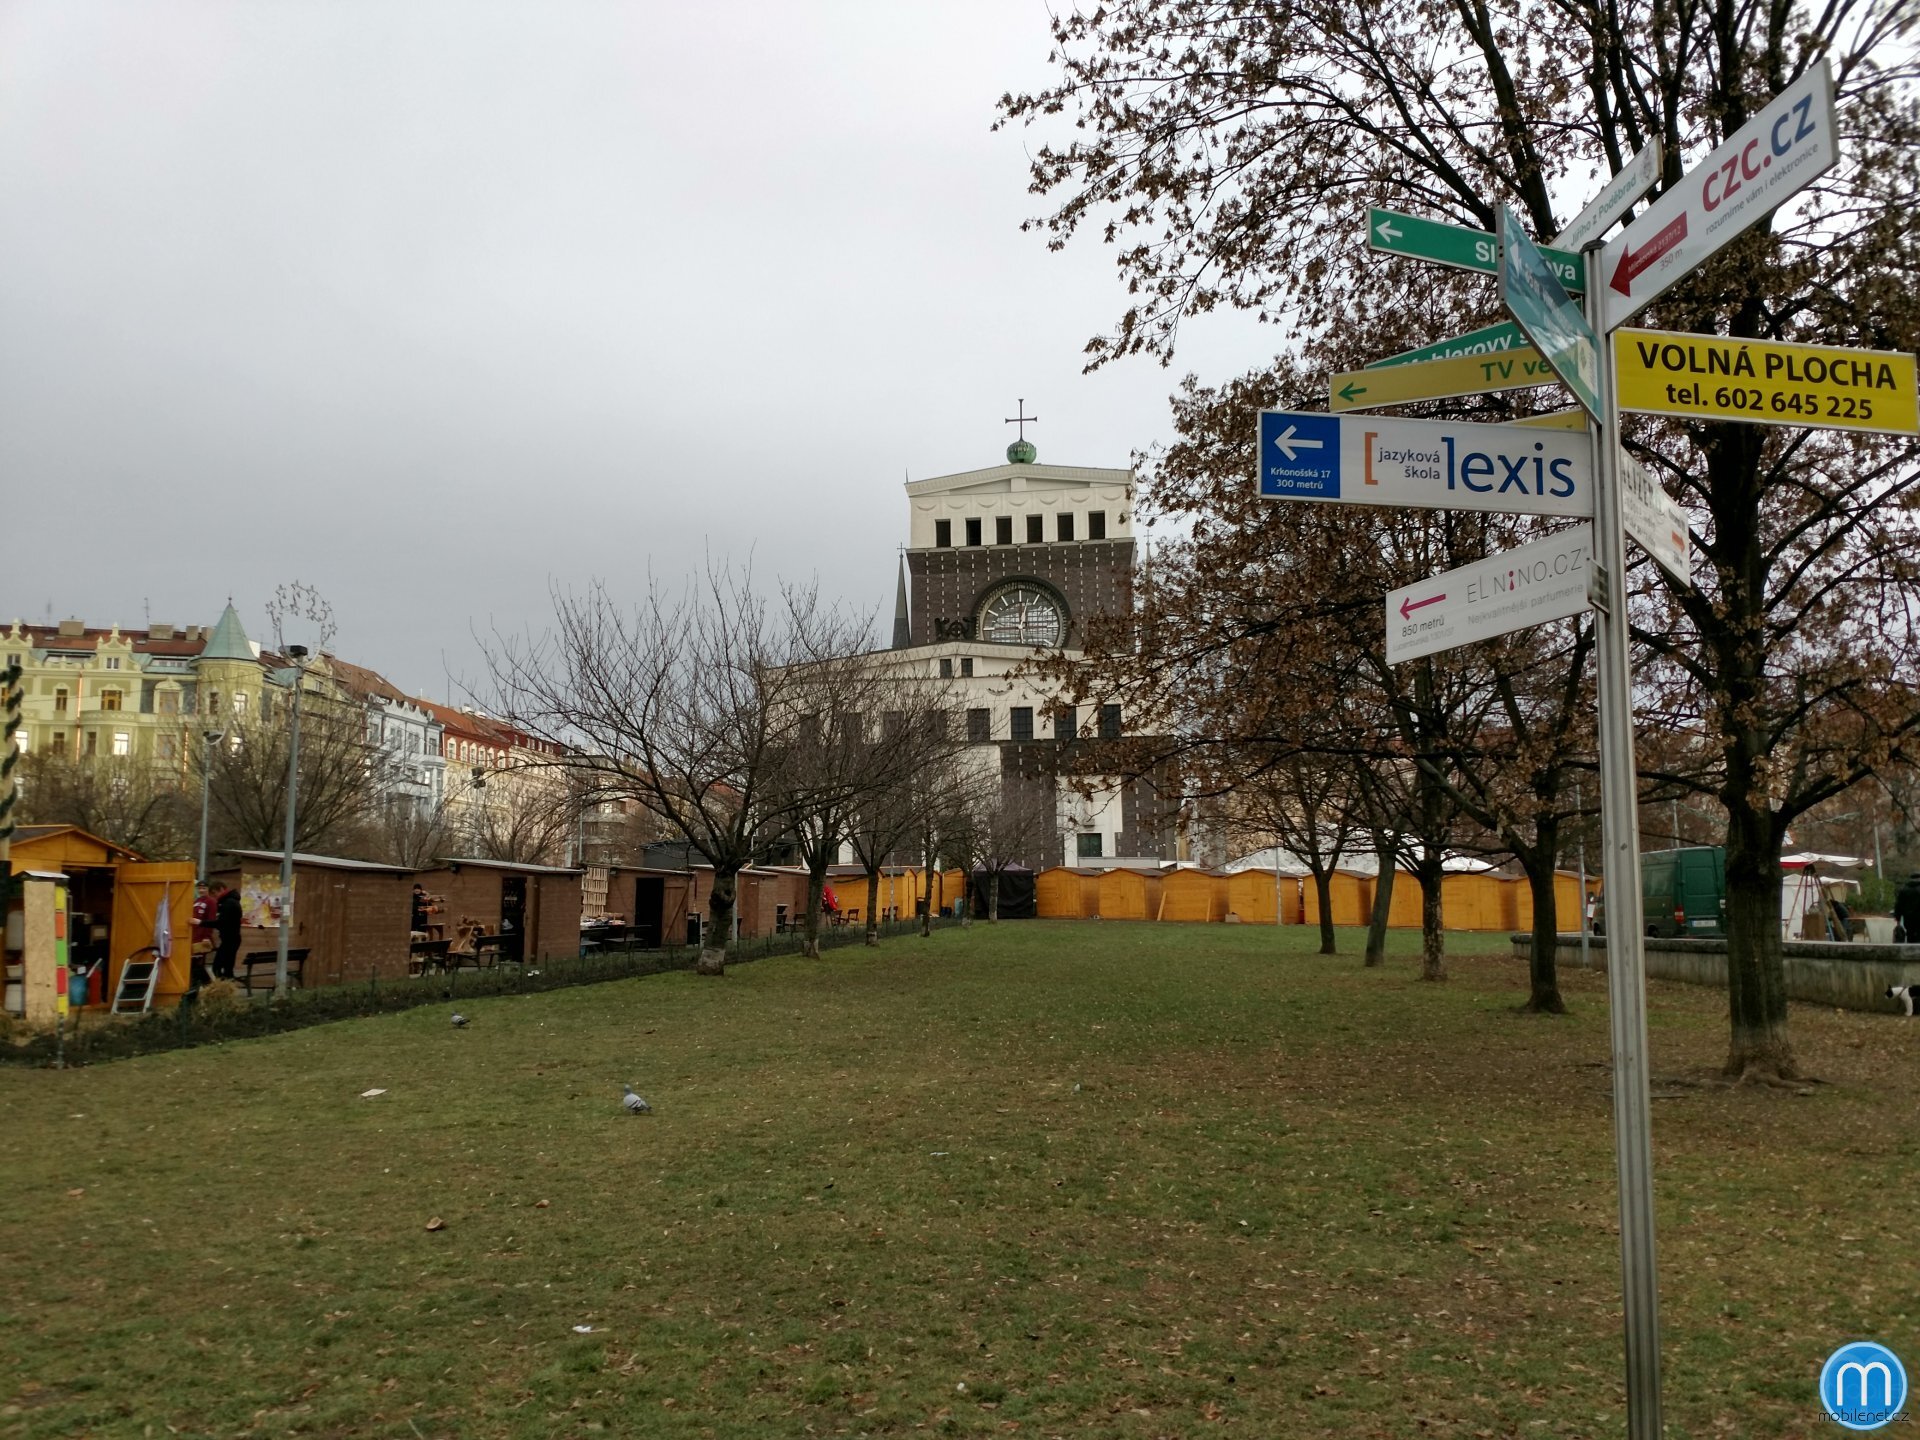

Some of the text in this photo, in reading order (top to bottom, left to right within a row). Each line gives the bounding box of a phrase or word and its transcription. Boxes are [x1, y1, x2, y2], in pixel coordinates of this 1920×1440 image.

[1702, 92, 1816, 213] CZC.CZ
[1769, 143, 1819, 186] elektronice
[1592, 214, 1598, 225] z
[1599, 172, 1637, 219] Poděbrad
[1660, 248, 1683, 271] 350 m
[1480, 360, 1514, 381] TV
[1636, 341, 1756, 378] VOLNÁ
[1764, 352, 1897, 391] PLOCHA
[1665, 382, 1873, 420] tel. 602 645 225
[1378, 447, 1441, 463] jazyková
[1270, 467, 1331, 479] Krkonošská 17
[1404, 465, 1441, 480] škola
[1441, 436, 1575, 498] lexis
[1276, 478, 1324, 490] 300 metrů
[1530, 584, 1584, 608] parfumerie
[1402, 623, 1418, 638] 850
